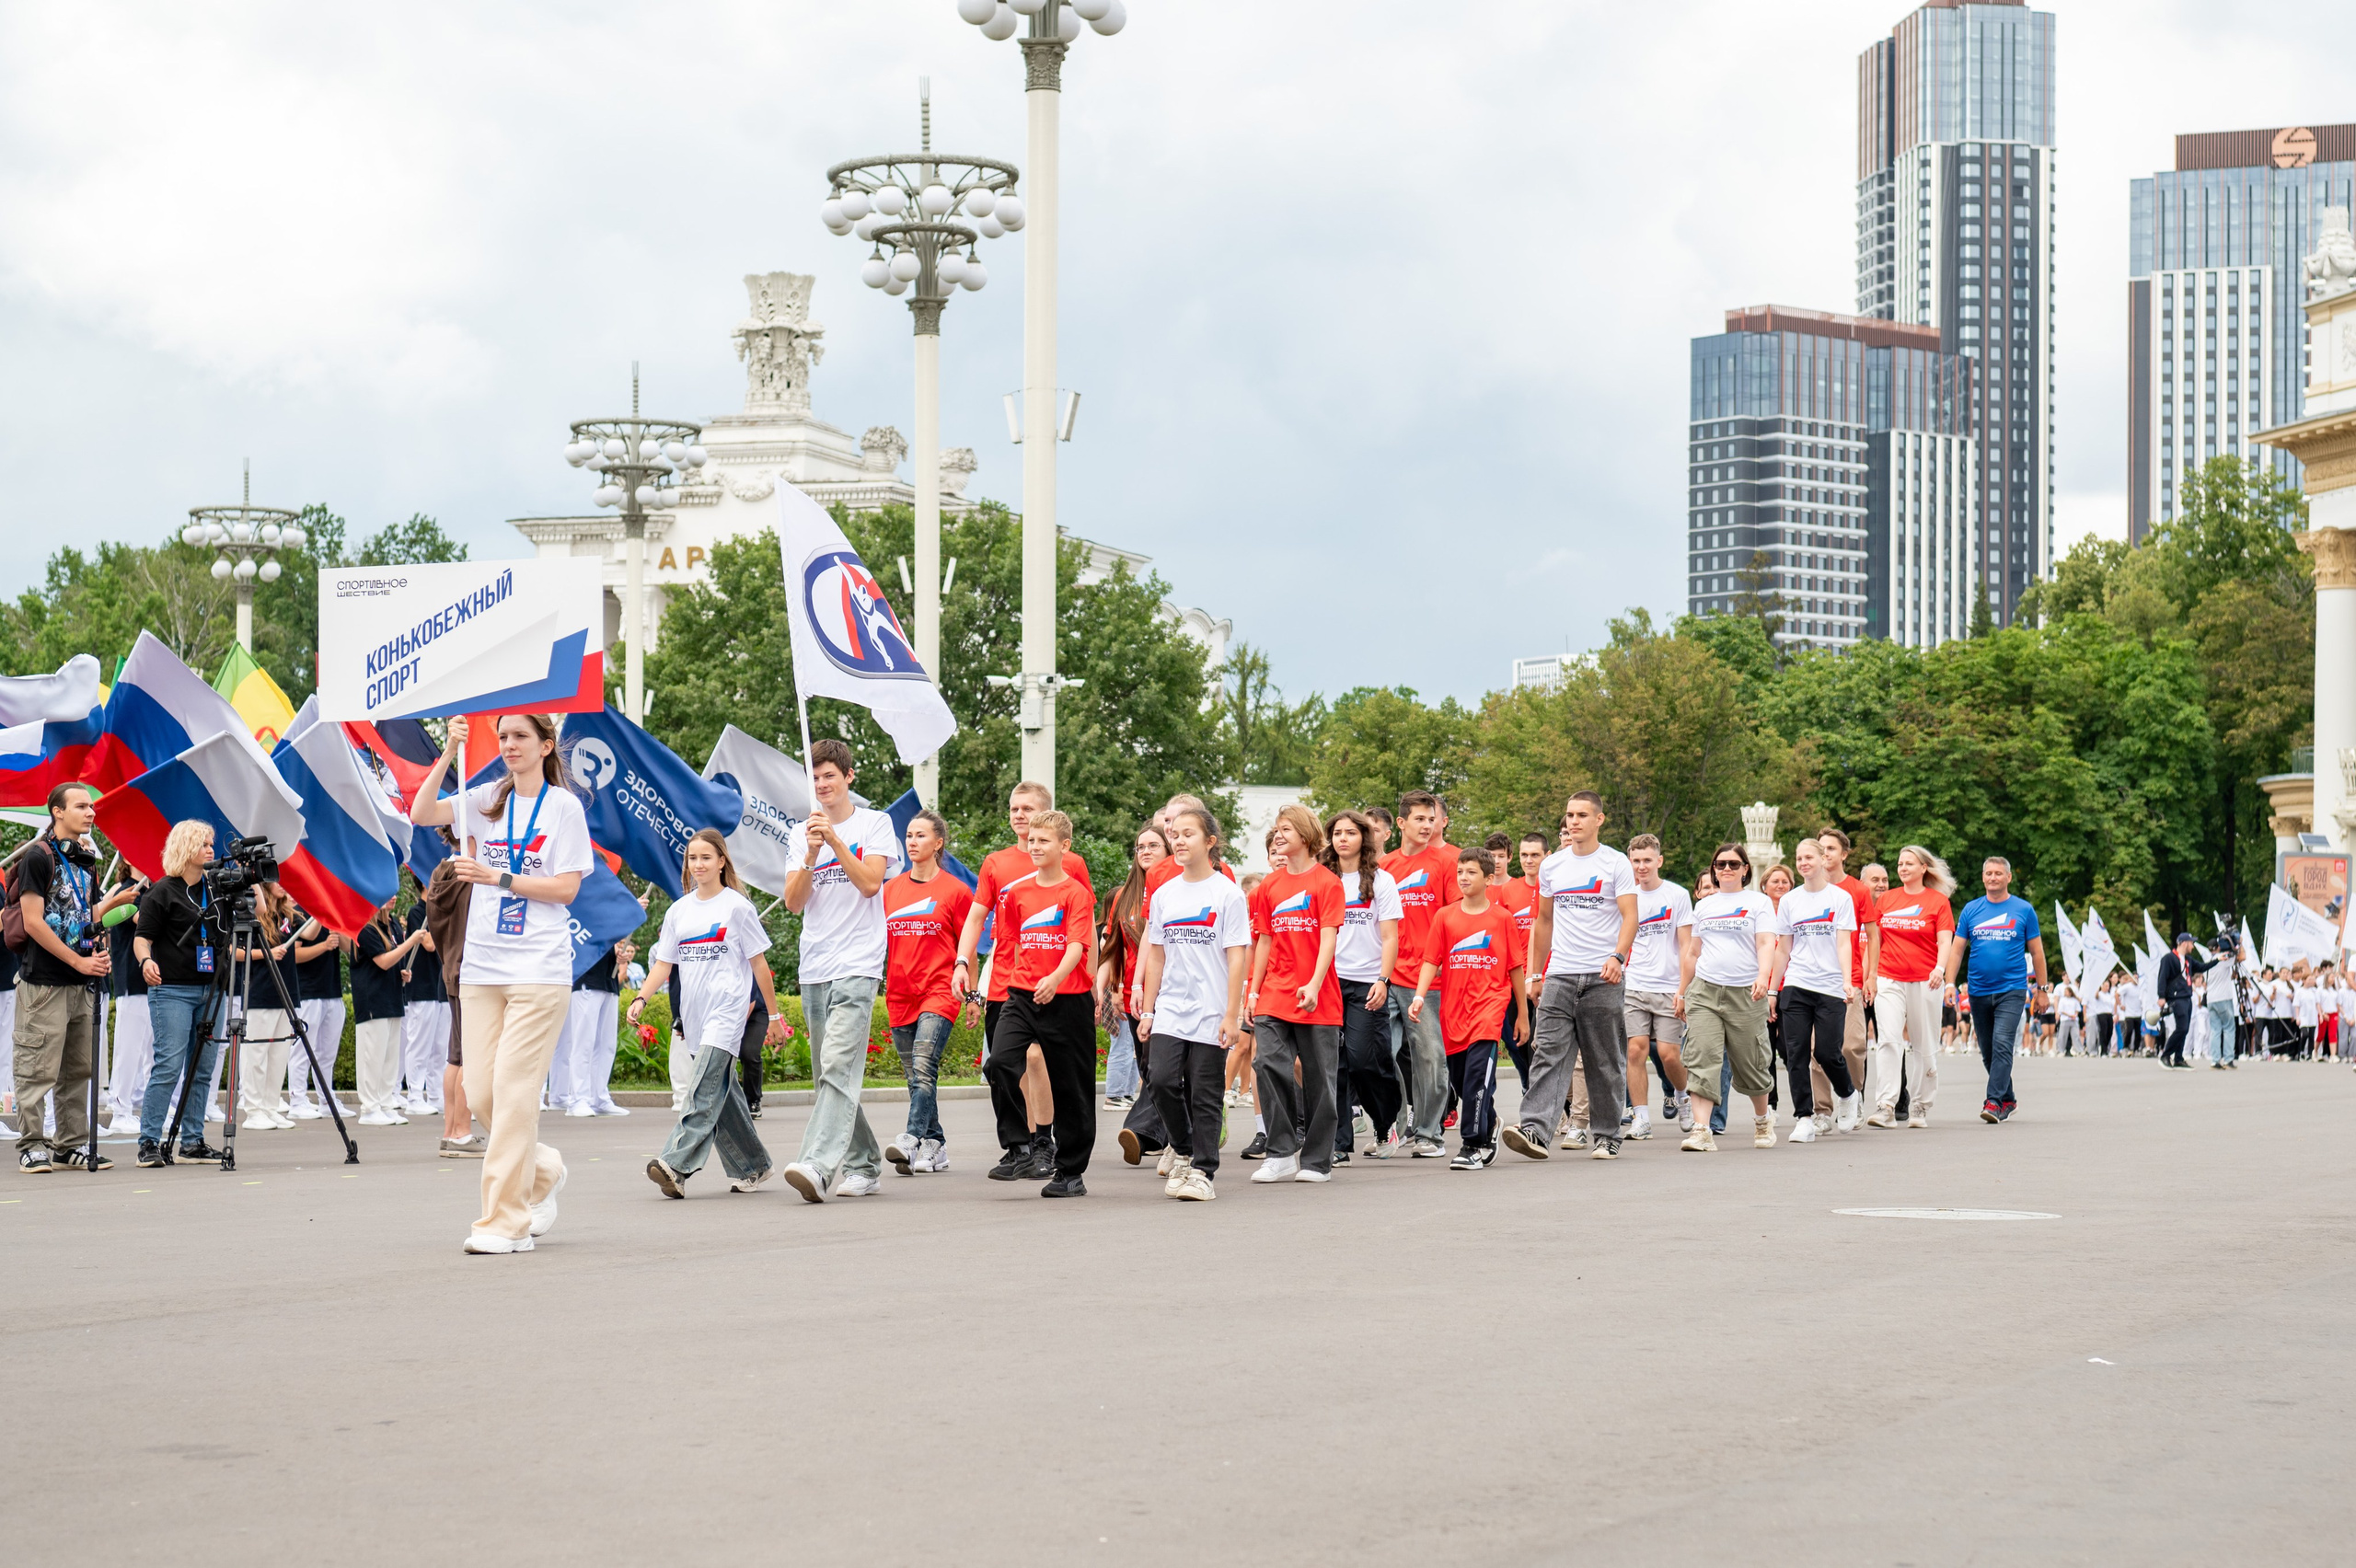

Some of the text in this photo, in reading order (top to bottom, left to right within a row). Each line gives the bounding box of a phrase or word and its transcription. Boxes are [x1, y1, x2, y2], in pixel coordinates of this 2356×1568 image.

[366, 568, 513, 679] КОНЬКОБЕЖНЫЙ
[365, 656, 421, 710] СПОРТ
[617, 789, 687, 855] ОТЕЧЕСТВ
[624, 769, 697, 840] ЗДОРОВО
